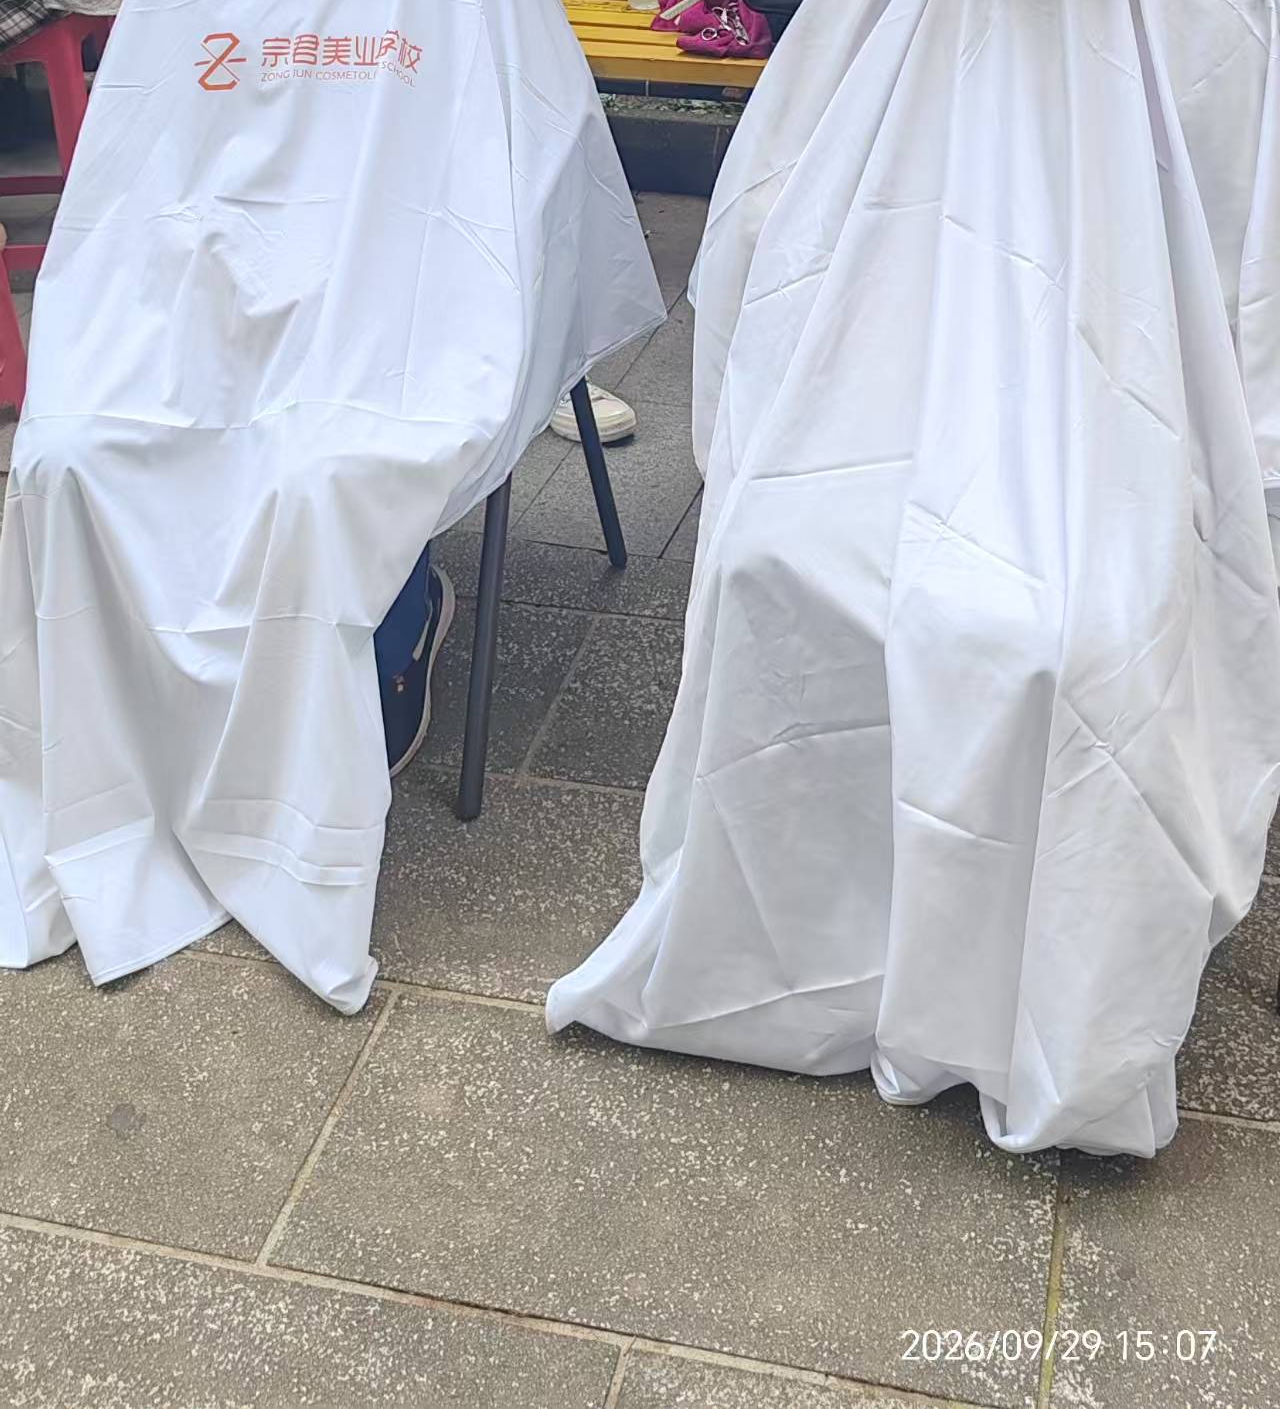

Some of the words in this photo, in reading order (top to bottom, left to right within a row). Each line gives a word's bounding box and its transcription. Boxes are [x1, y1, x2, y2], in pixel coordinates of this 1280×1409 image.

[261, 70, 290, 82] ZONG
[292, 70, 312, 79] JUN
[381, 60, 416, 88] SCHOOL
